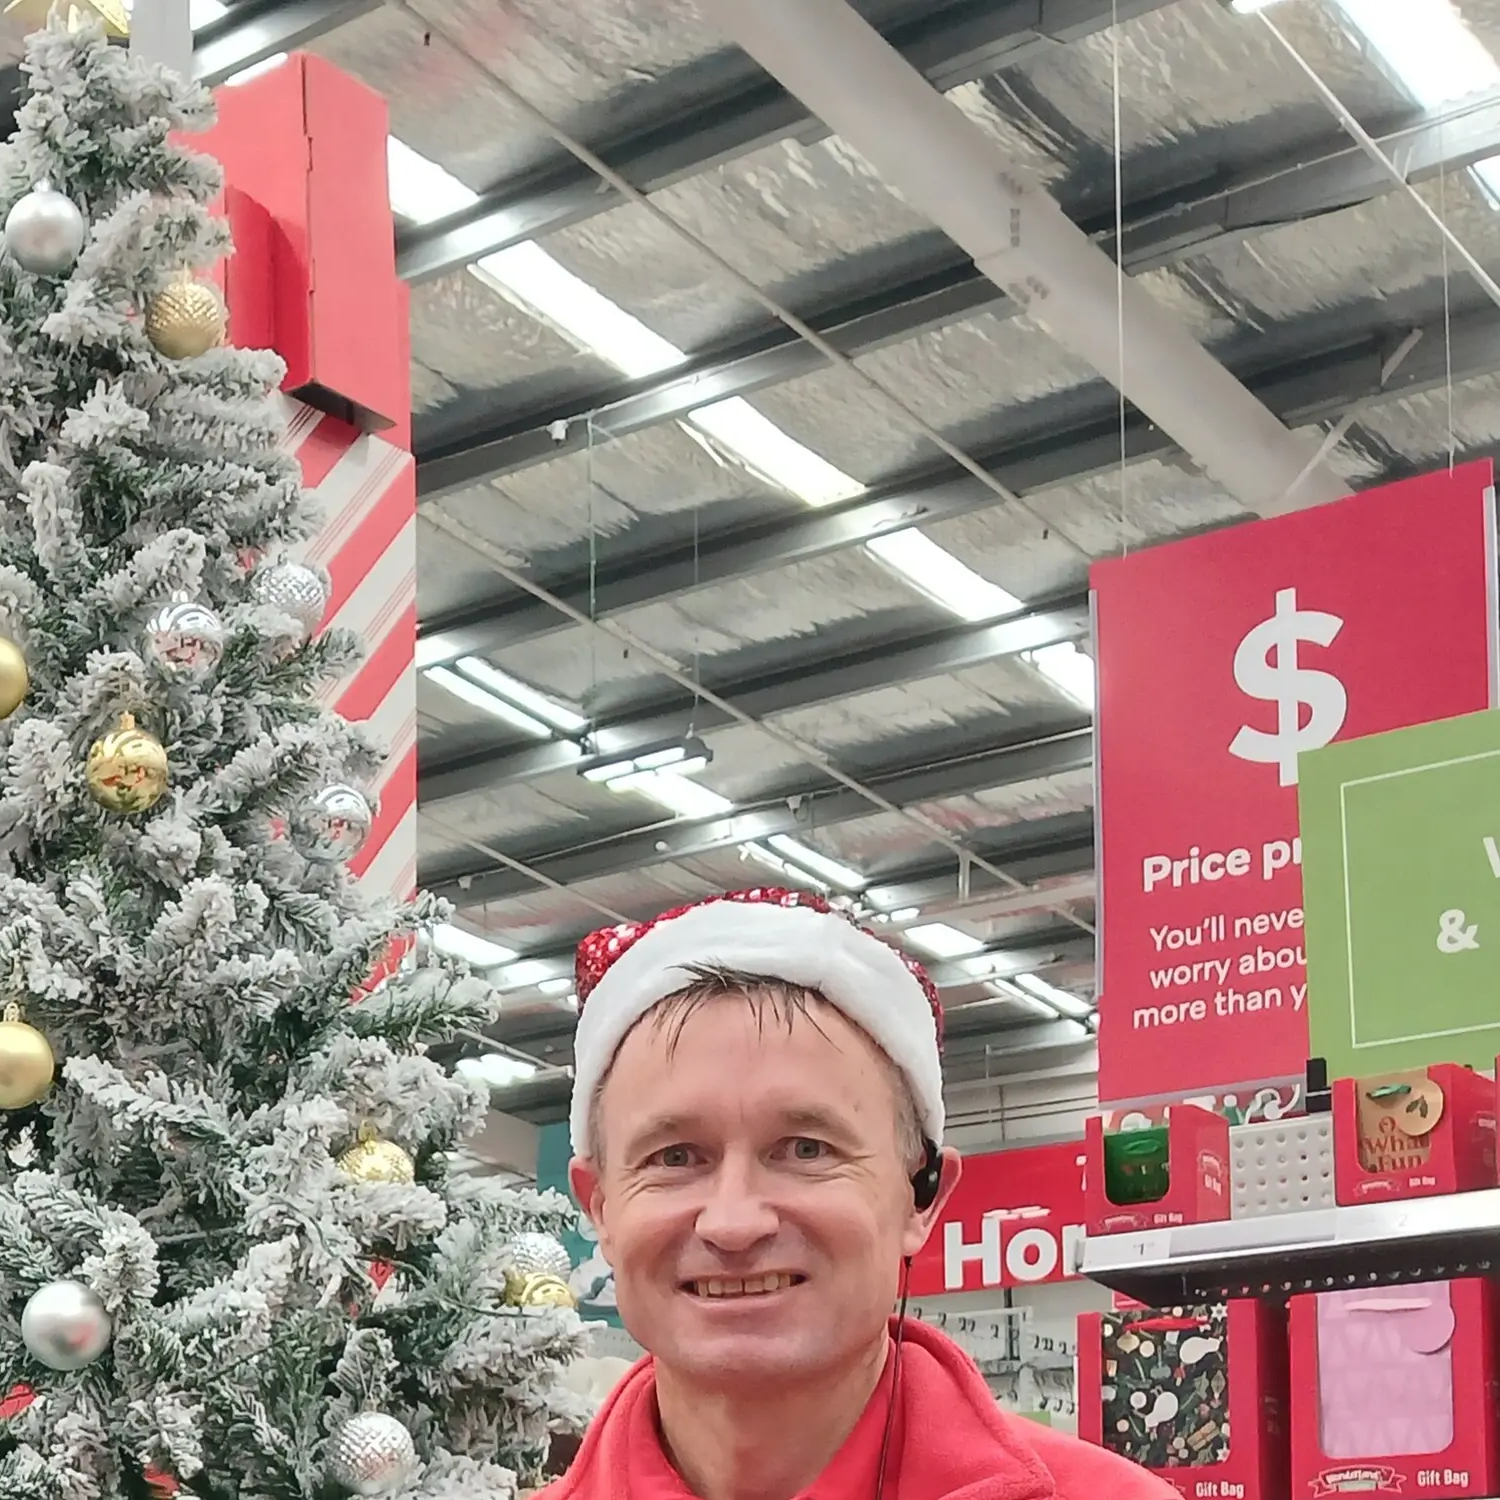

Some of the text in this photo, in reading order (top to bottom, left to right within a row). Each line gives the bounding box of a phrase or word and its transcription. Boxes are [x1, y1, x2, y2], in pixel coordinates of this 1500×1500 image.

[1143, 846, 1251, 893] Price
[1150, 914, 1225, 952] You'll
[1436, 908, 1480, 954] &
[1150, 958, 1231, 990] worry
[1133, 1001, 1207, 1029] more
[1214, 987, 1281, 1016] than
[1196, 1480, 1244, 1500] Gift Bag
[1417, 1468, 1469, 1488] Gift Bag
